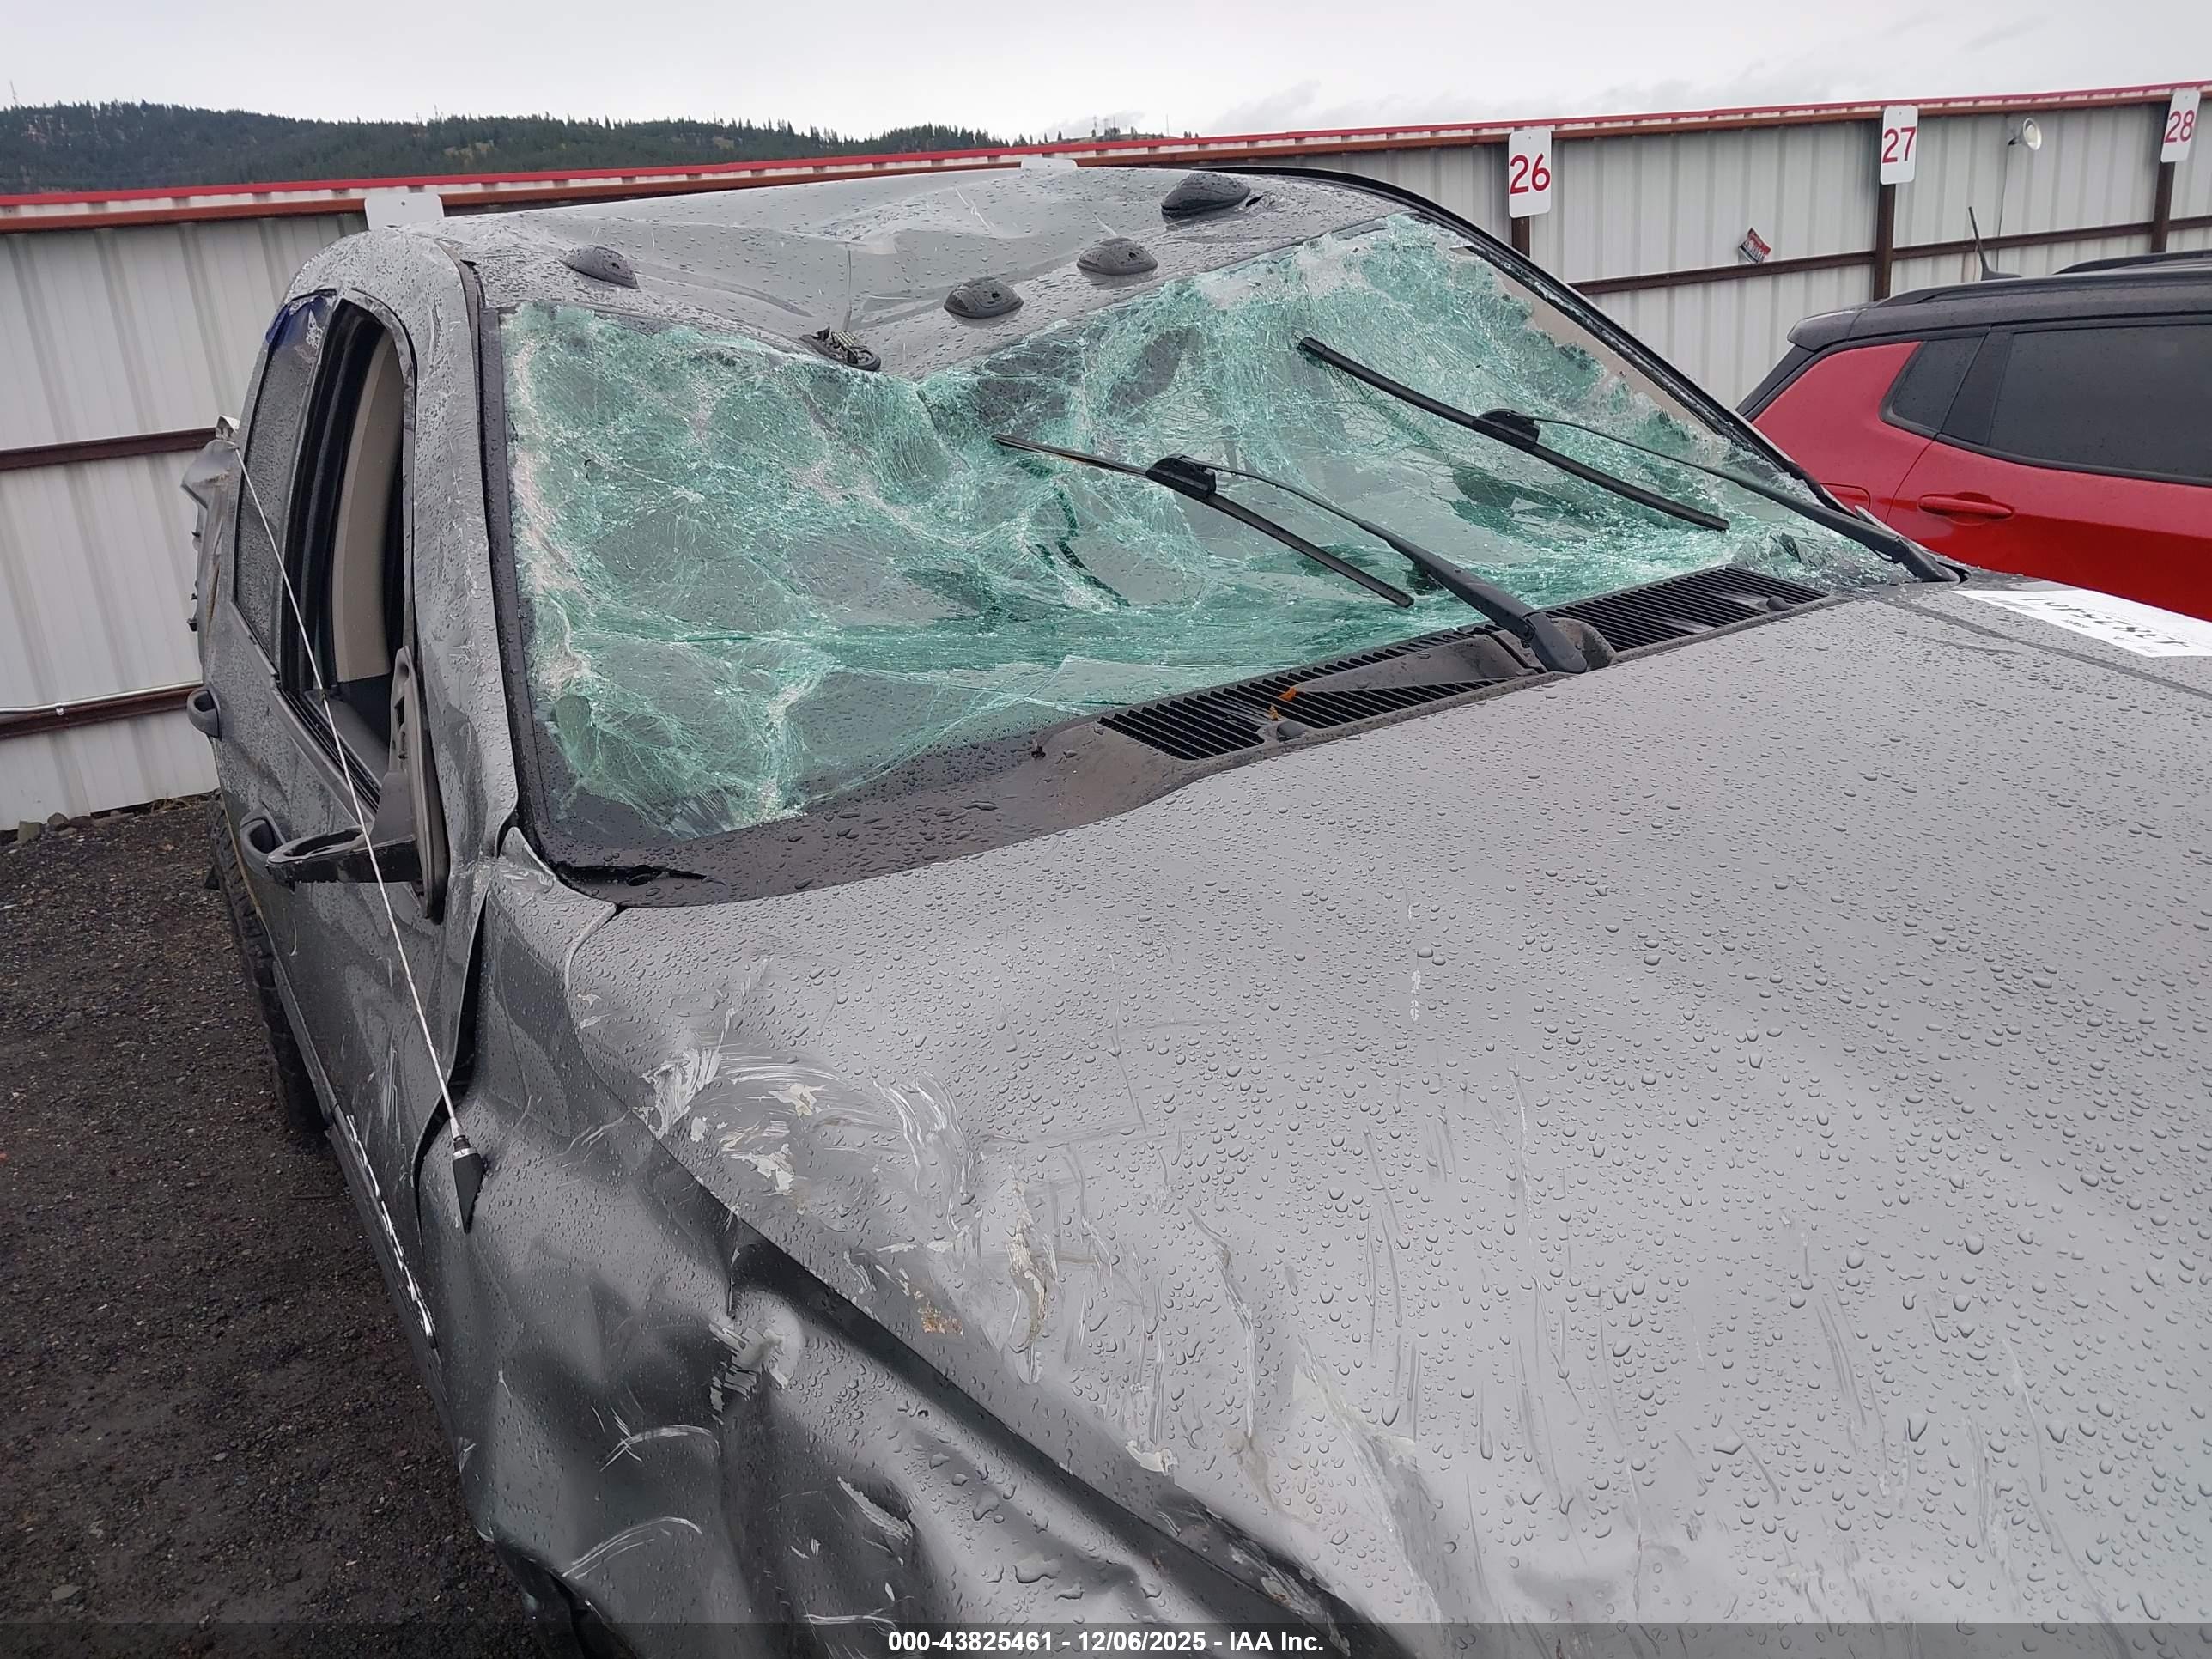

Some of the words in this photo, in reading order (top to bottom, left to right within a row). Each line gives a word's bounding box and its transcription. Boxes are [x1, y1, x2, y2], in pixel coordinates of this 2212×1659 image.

[1882, 126, 1917, 164] 27
[2165, 109, 2195, 143] 28
[1510, 153, 1551, 195] 26
